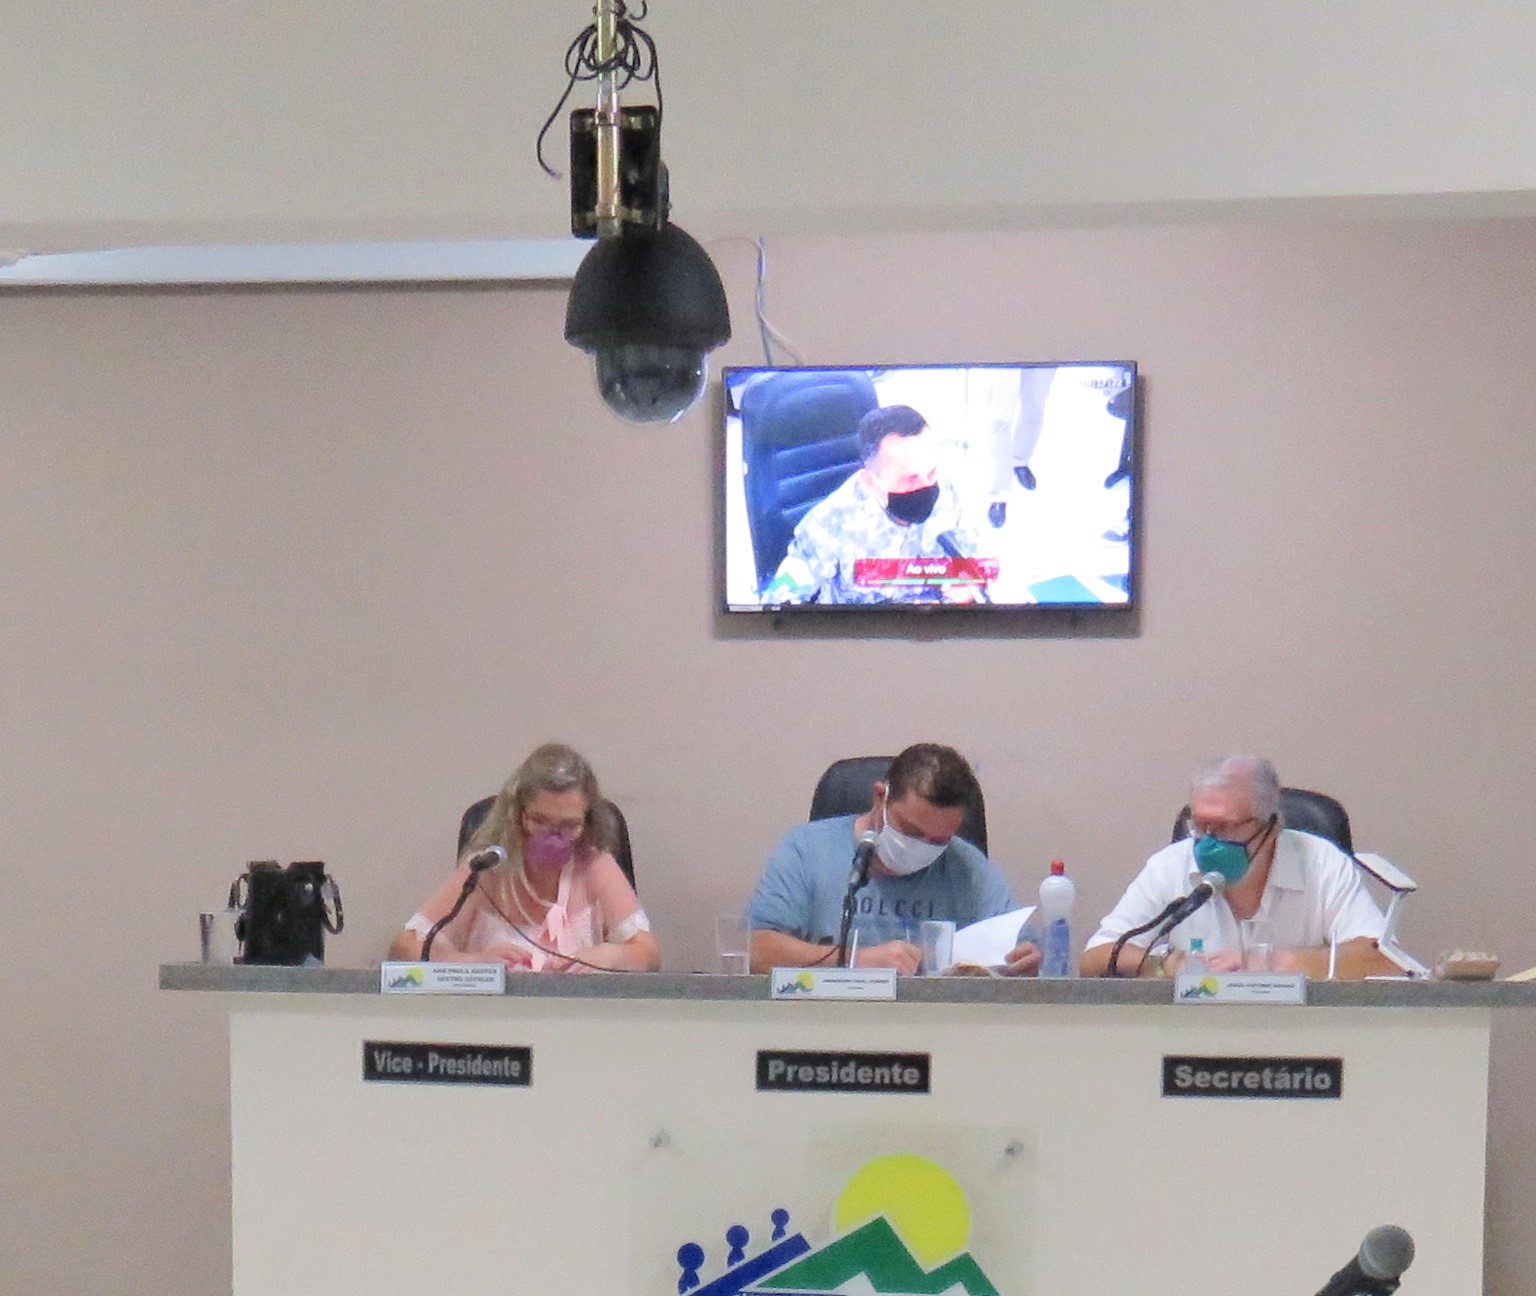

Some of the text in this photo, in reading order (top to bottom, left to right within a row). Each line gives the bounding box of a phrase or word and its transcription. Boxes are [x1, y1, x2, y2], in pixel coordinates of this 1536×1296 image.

[848, 897, 933, 918] OLCCI
[373, 1050, 413, 1074] Vice
[427, 1051, 522, 1078] Presidente
[767, 1058, 921, 1086] Presidente
[1174, 1064, 1332, 1091] Secretário
